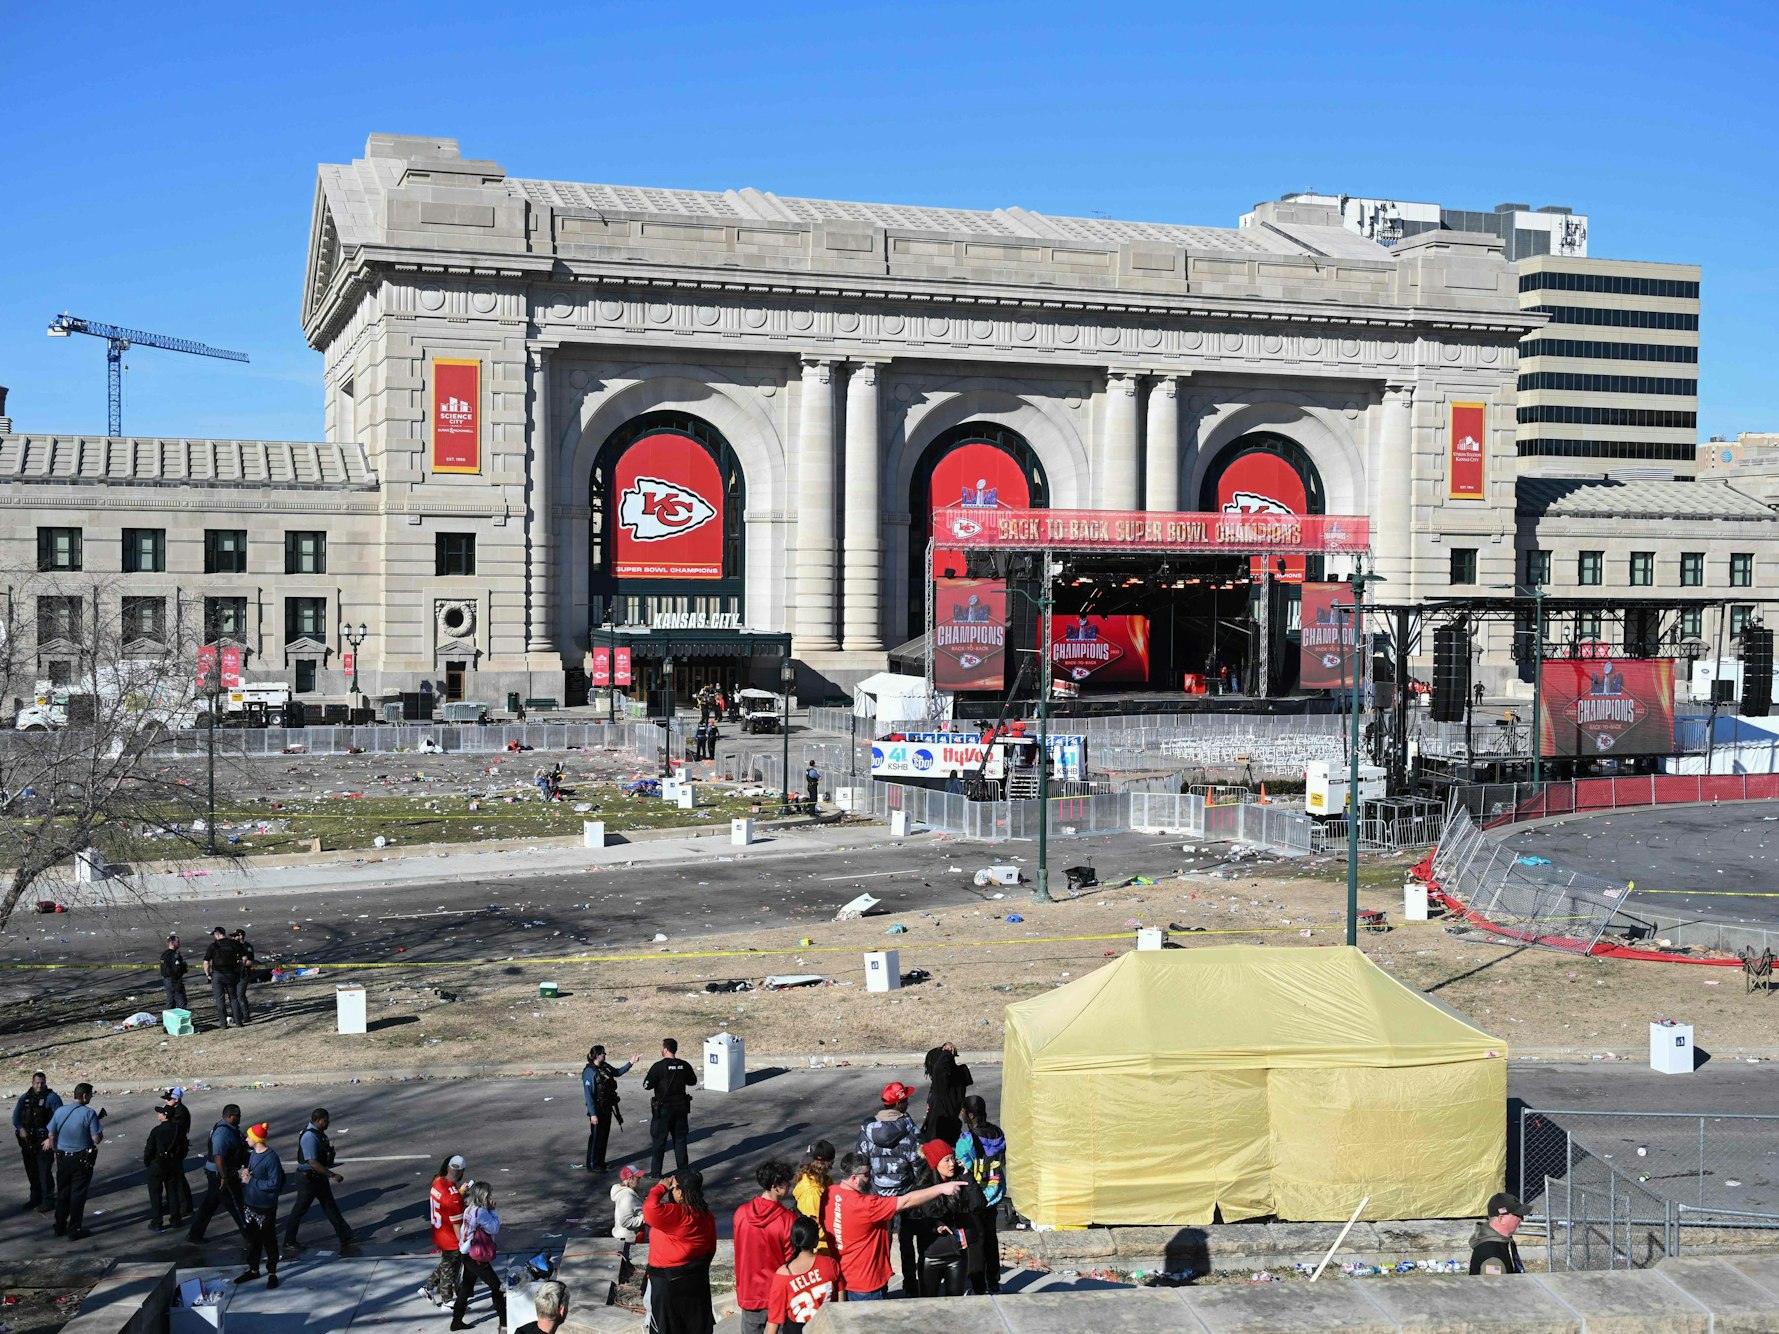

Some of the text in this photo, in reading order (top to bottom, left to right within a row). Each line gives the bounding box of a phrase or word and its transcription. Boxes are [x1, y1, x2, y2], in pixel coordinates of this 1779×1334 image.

[642, 492, 693, 527] KC
[1115, 519, 1164, 542] SUPER
[1166, 521, 1209, 543] BOWL
[1214, 522, 1302, 545] CHAMPIONS
[670, 566, 719, 574] CHAMPIONS
[652, 612, 741, 630] KANSAS CITY
[937, 625, 1004, 647] CHAMPIONS
[1053, 643, 1110, 661] CHAMPIONS
[1577, 699, 1635, 723] CHAMPIONS
[888, 747, 907, 762] 41
[887, 762, 909, 771] KSHB
[1056, 767, 1078, 775] KSHB
[789, 1268, 823, 1293] KELCE
[789, 1281, 834, 1324] 87
